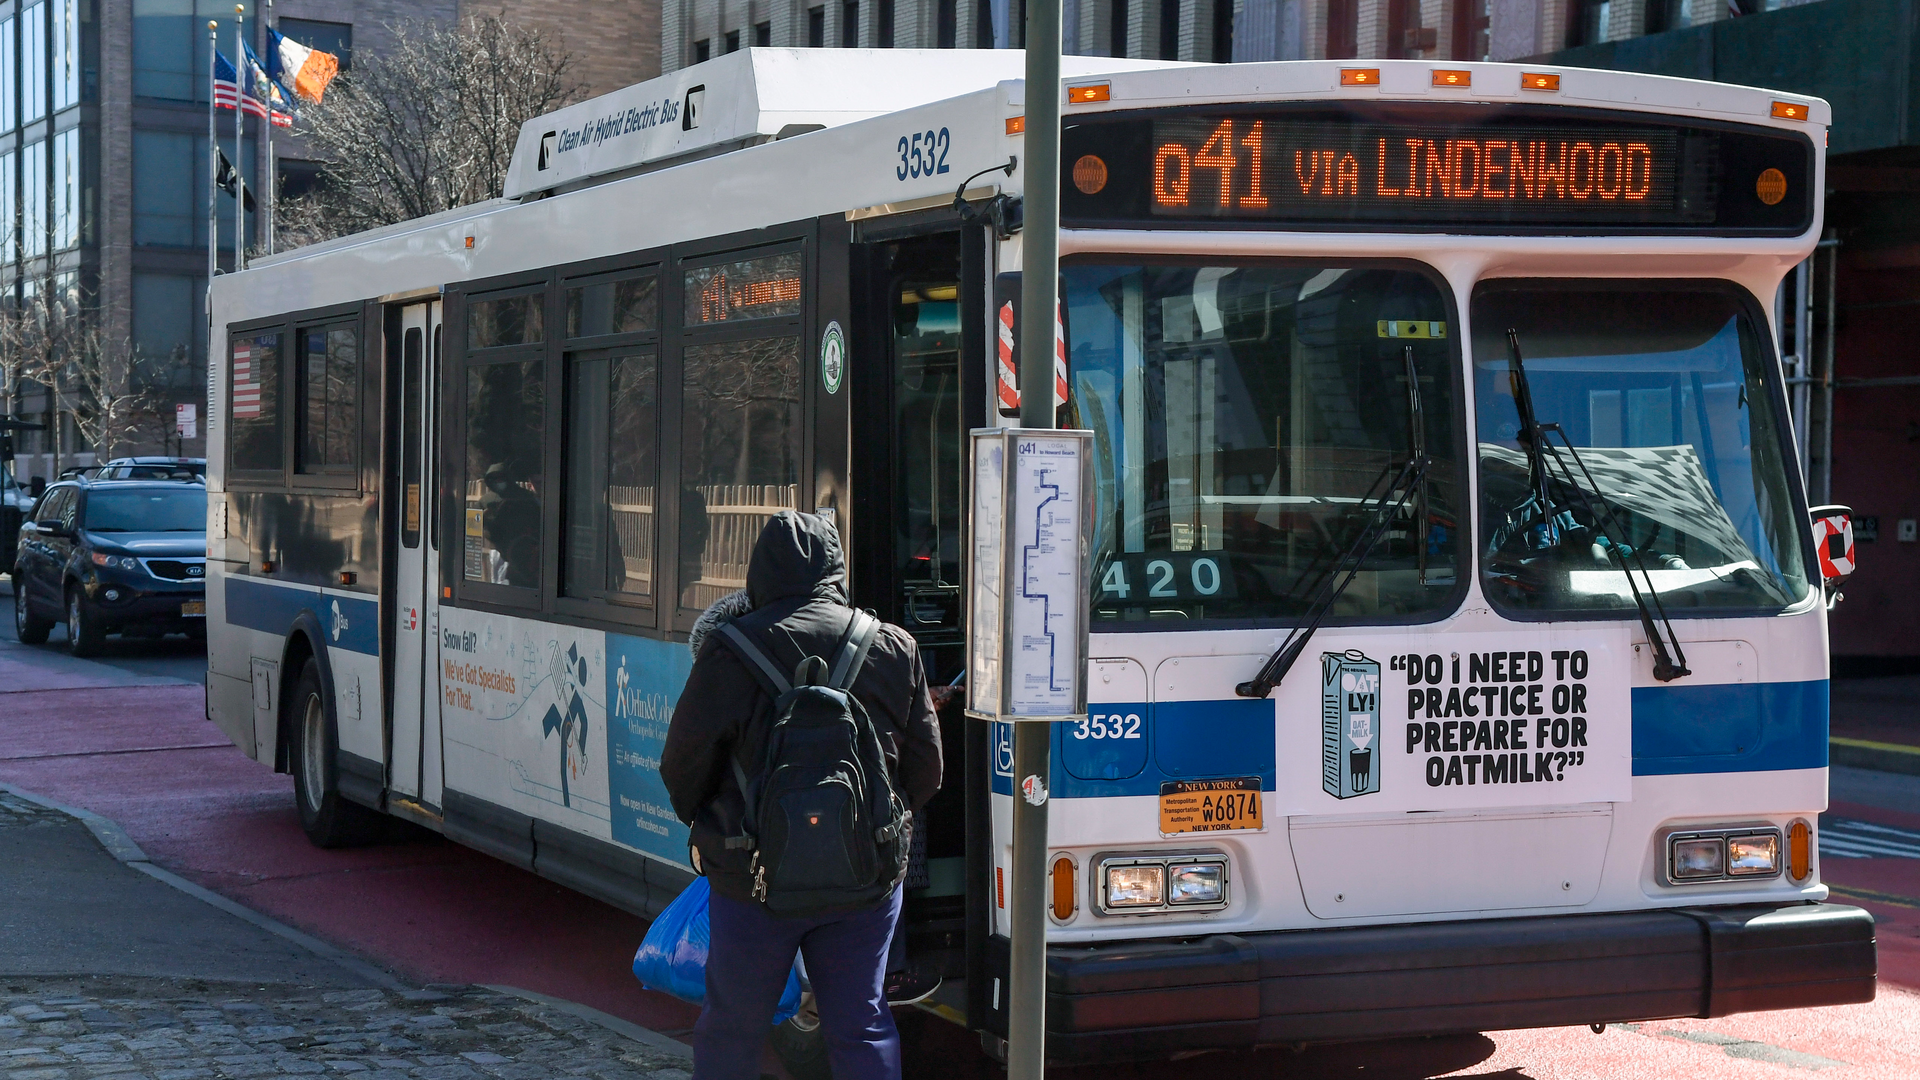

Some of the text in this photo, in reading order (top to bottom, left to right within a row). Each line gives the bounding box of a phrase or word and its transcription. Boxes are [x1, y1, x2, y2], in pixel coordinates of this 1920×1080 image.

[558, 98, 679, 153] Clean Air Hybrid Electric Bus
[896, 126, 950, 181] 3532
[1155, 119, 1650, 207] Q41 VIA LINDENWOOD
[1018, 442, 1036, 454] Q41
[340, 613, 348, 630] Bus
[444, 628, 461, 650] Snow
[462, 630, 476, 653] fall?
[444, 658, 516, 694] We've Got Specialists
[1452, 652, 1460, 684] I
[1469, 651, 1543, 683] NEED
[1551, 650, 1588, 681] TO
[445, 685, 455, 706] For
[1348, 693, 1374, 712] LY!
[1408, 684, 1586, 720] PRACTICE OR
[1073, 714, 1140, 740] 3532
[1406, 717, 1587, 754] PREPARE FOR
[1185, 781, 1237, 791] NEW YORK
[620, 794, 630, 807] Now
[630, 800, 640, 812] open
[641, 800, 646, 812] in
[657, 806, 674, 821] Gardens
